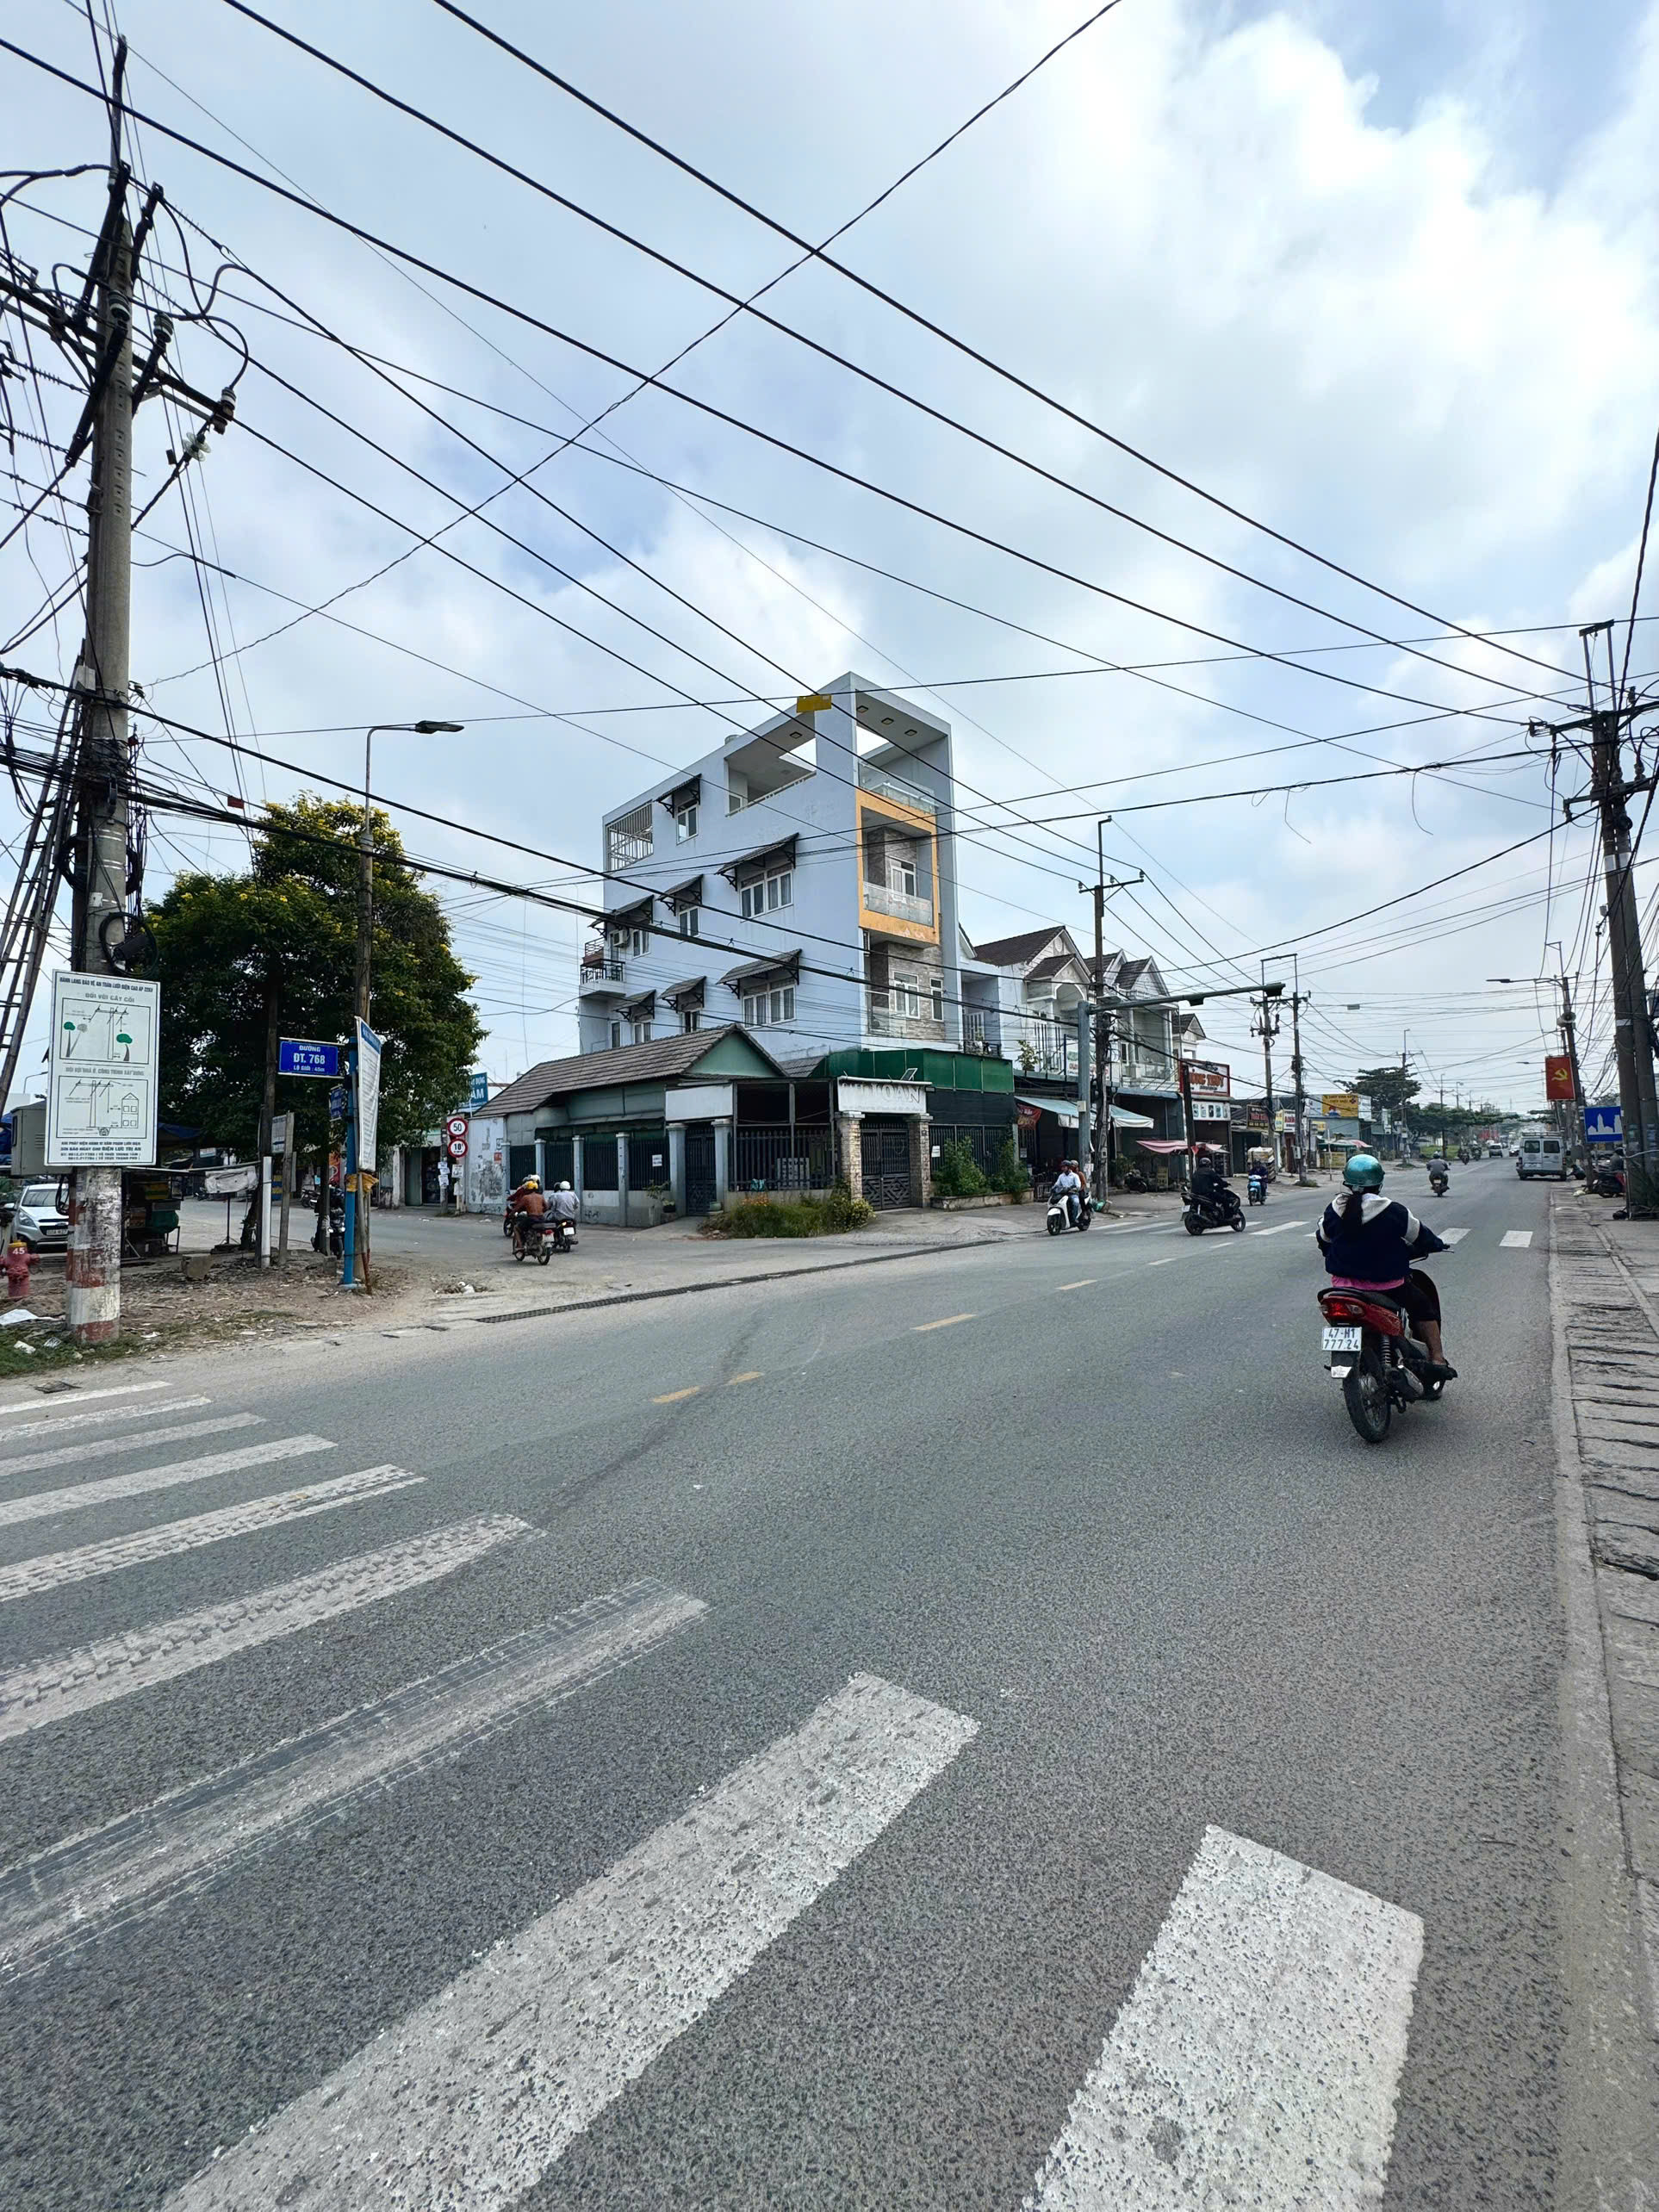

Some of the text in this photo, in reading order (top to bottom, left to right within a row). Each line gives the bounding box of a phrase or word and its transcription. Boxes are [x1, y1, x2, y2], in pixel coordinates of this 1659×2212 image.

[309, 1054, 325, 1064] 768
[453, 1123, 462, 1132] 50
[1329, 1328, 1355, 1338] 47-H1
[1324, 1339, 1359, 1349] 777.24
